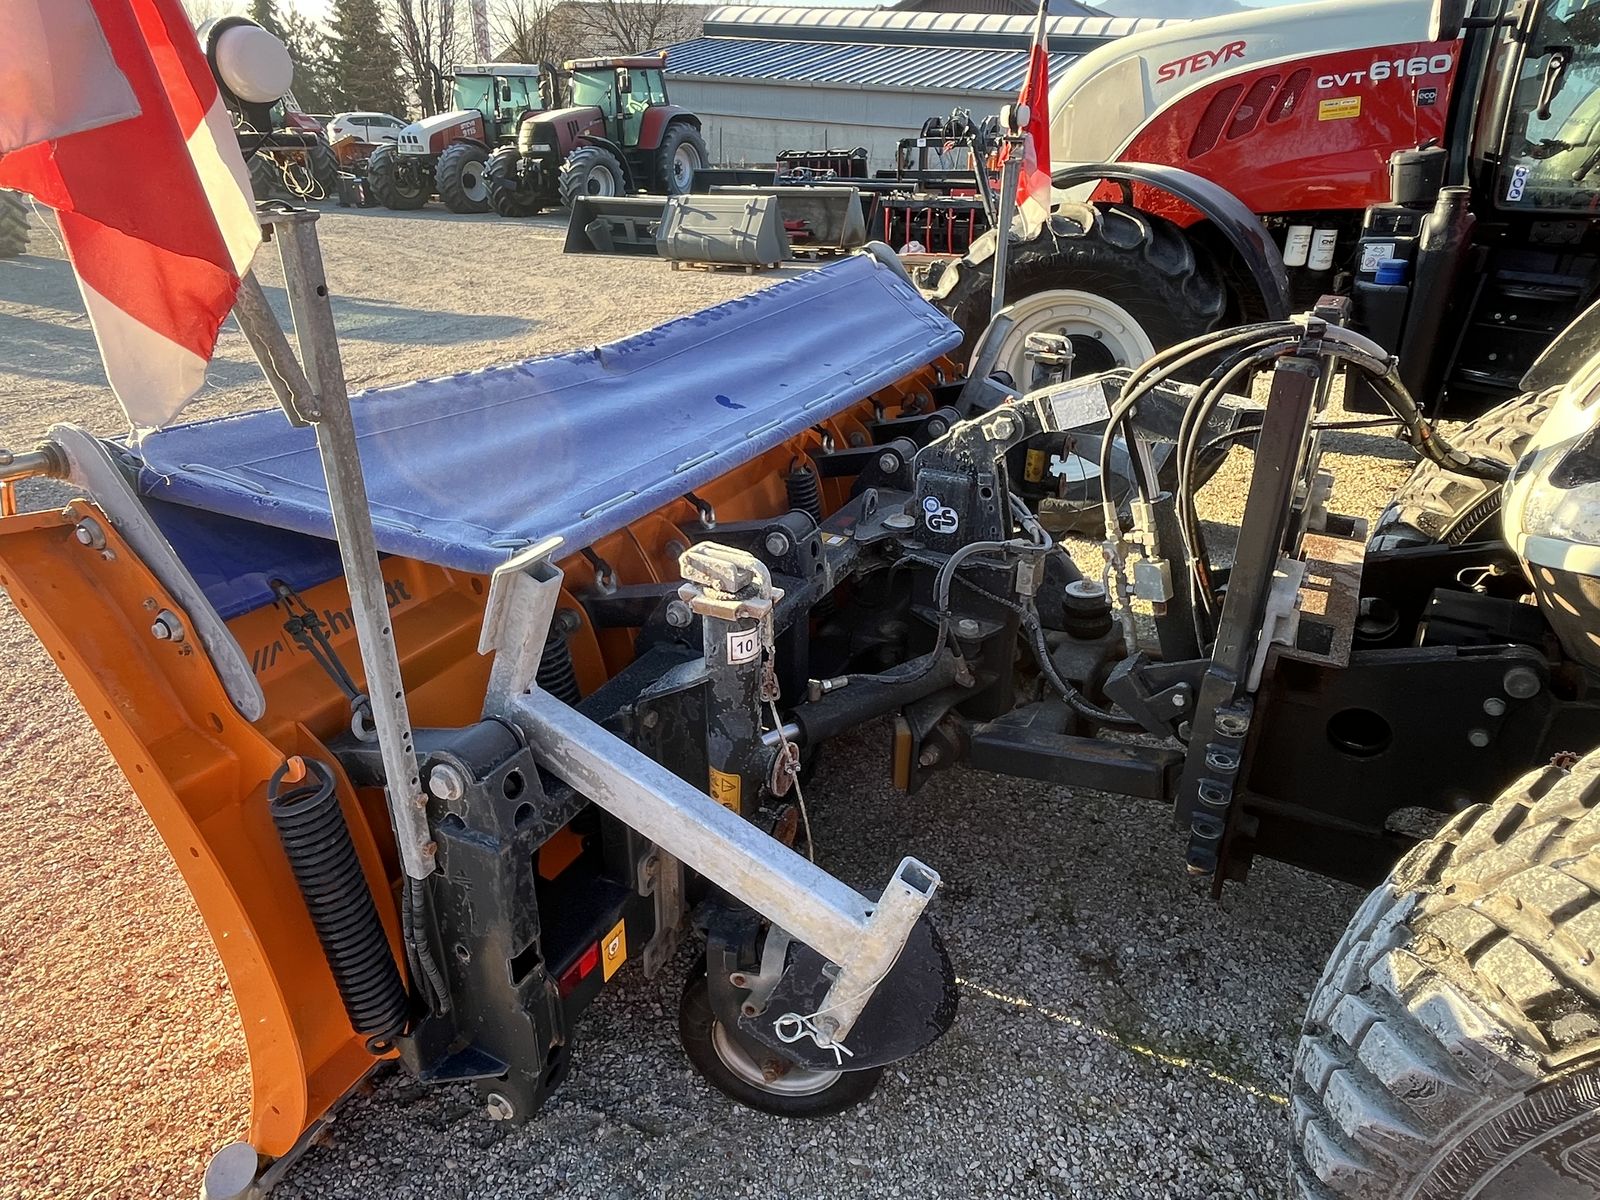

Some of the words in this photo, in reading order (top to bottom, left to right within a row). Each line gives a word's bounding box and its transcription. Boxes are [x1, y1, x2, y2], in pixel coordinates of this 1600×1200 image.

[1156, 40, 1247, 84] STEYR
[1317, 71, 1367, 89] CVT
[1369, 54, 1452, 80] 6160
[928, 509, 956, 530] GS
[737, 639, 752, 654] 10
